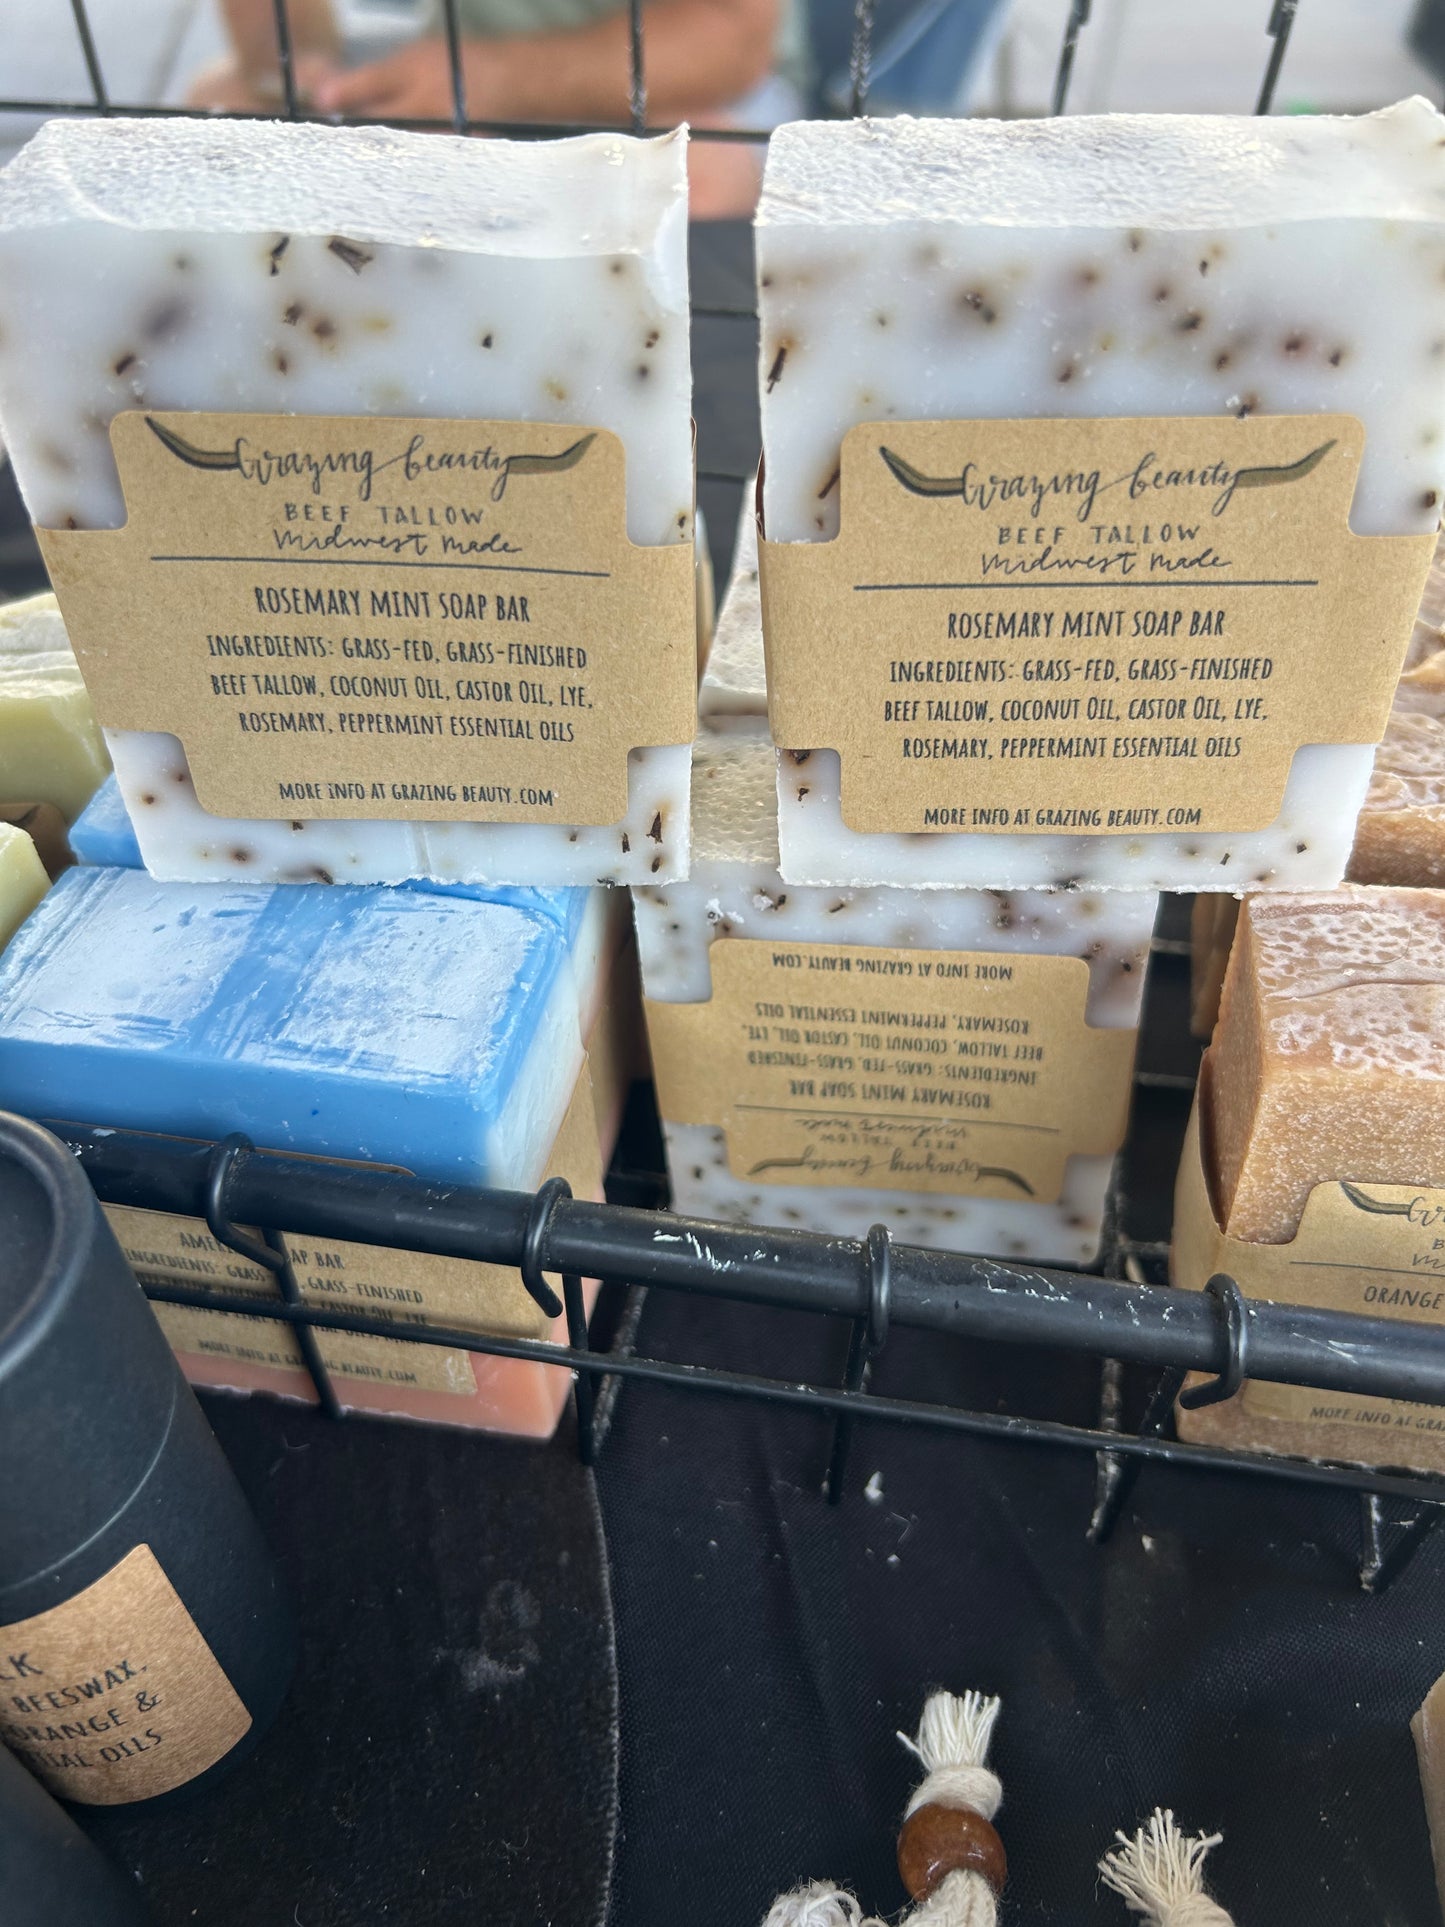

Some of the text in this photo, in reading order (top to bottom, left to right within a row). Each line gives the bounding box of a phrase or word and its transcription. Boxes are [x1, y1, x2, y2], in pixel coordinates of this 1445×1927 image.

[236, 434, 511, 501] Grazing beauty
[961, 452, 1240, 523] Grazing beauty
[284, 502, 484, 525] BEEF TALLOW
[998, 524, 1201, 545] BEEF TALLOW
[255, 586, 530, 622] ROSEMARY MINT SOAP BAR
[947, 610, 1226, 639] ROSEMARY MINT SOAP BAR
[206, 634, 588, 669] INGREDIENTS: GRASS-FED, GRASS-FINISHED
[889, 657, 1273, 683] INGREDIENTS: GRASS-FED, GRASS-FINISHED
[210, 674, 247, 696] BEEF
[252, 674, 325, 698] TALLOW,
[330, 675, 408, 698] COCONUT
[456, 680, 513, 702] CASTOR
[560, 685, 593, 709] LYE,
[884, 700, 920, 722] BEEF
[927, 700, 994, 723] TALLOW,
[1001, 698, 1081, 721] COCONUT
[1127, 698, 1187, 721] CASTOR
[1234, 698, 1268, 721] LYE,
[239, 712, 574, 742] ROSEMARY, PEPPERMINT ESSENTIAL OILS
[903, 737, 1242, 760] ROSEMARY, PEPPERMINT ESSENTIAL OILS
[279, 783, 322, 800] MORE
[328, 783, 365, 800] INFO
[371, 784, 387, 800] AT
[392, 784, 457, 802] GRAZING
[924, 808, 966, 825] MORE
[972, 808, 1009, 825] INFO
[1014, 809, 1030, 825] AT
[1036, 809, 1100, 826] GRAZING
[855, 960, 913, 977] GRAZING
[916, 962, 933, 977] AT
[936, 963, 969, 979] INFO
[976, 965, 1013, 981] MORE
[755, 1002, 1029, 1035] ROSEMARY, PEPPERMINT ESSENTIAL OILS
[885, 1036, 948, 1056] COCONUT
[1012, 1044, 1044, 1062] BEEF
[937, 1064, 1038, 1086] INGREDIENTS:
[788, 1078, 992, 1109] ROSEMARY MINT SOAP BAR
[315, 1252, 345, 1270] BAR
[125, 1250, 222, 1274] INGREDIENTS:
[307, 1276, 424, 1303] GRASS-FINISHED
[1364, 1285, 1445, 1311] ORANGE
[11, 1659, 148, 1713] BEESWAX,
[135, 1691, 163, 1713] &
[100, 1728, 163, 1763] OILS
